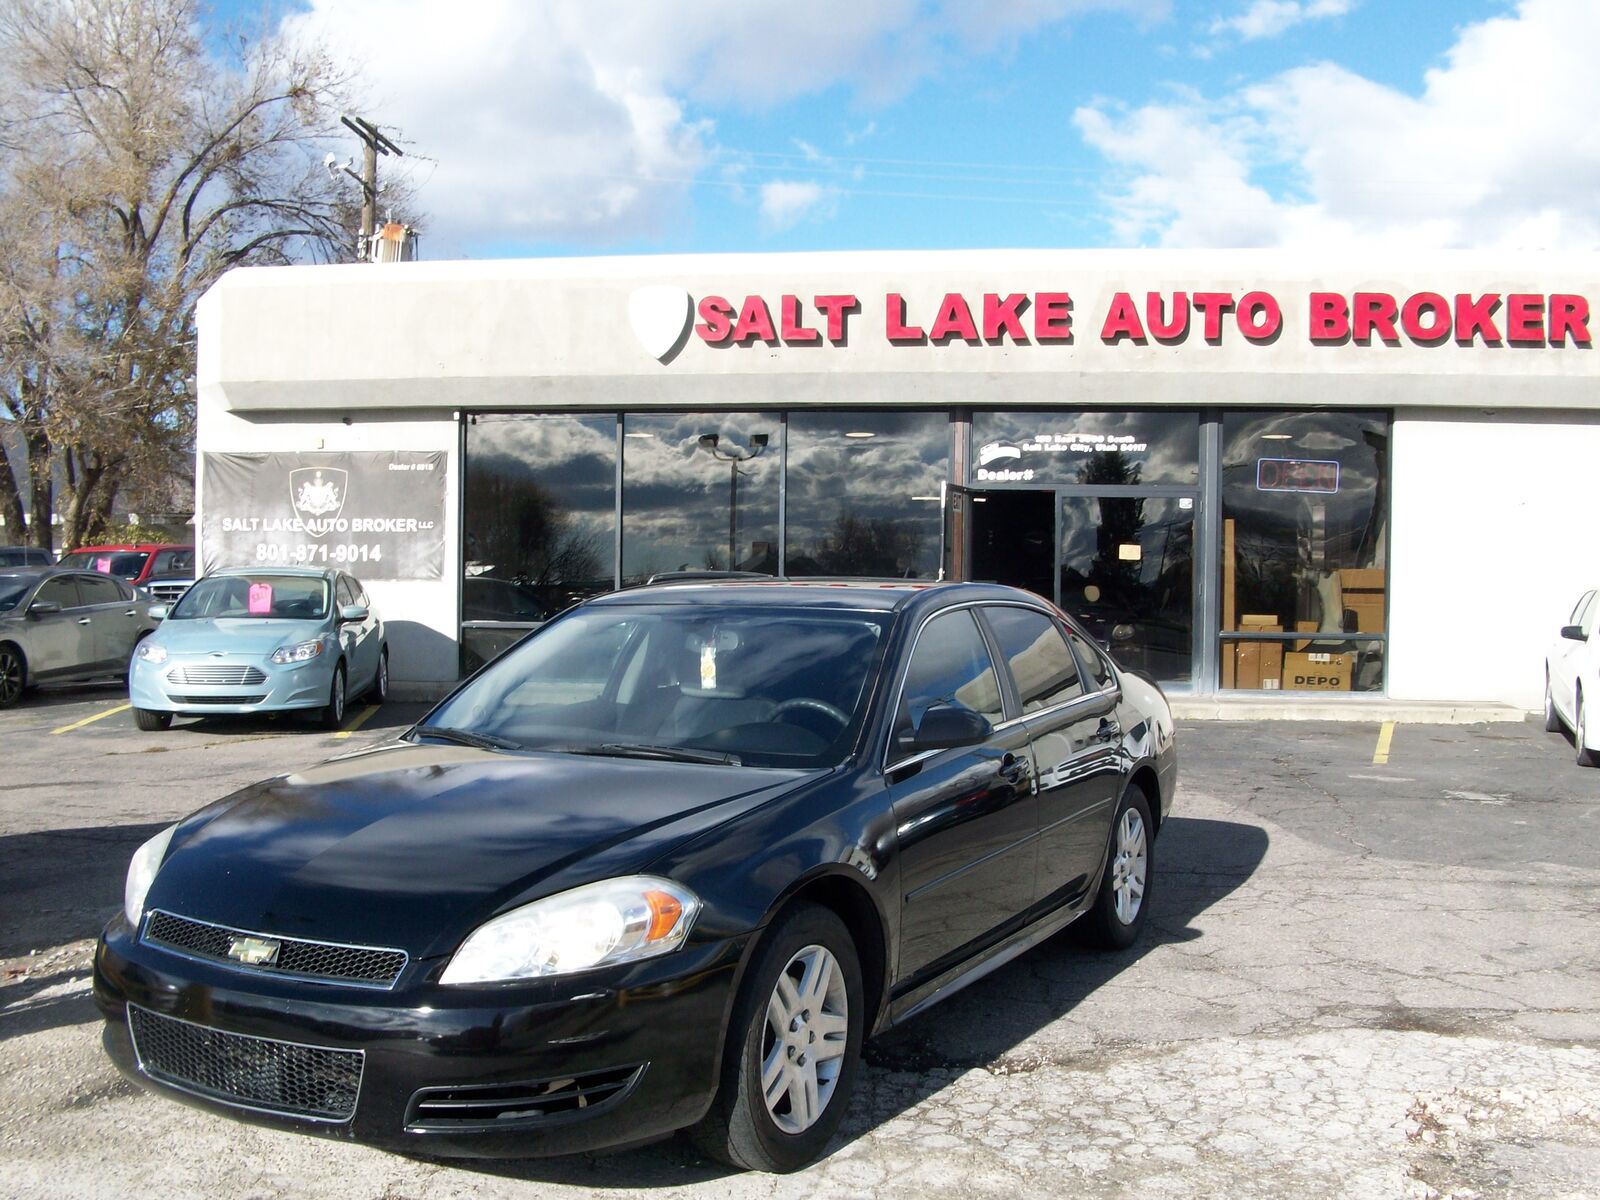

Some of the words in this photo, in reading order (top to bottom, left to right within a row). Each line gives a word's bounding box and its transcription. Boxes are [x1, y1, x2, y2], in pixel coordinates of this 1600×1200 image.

[695, 293, 861, 348] SALT
[886, 292, 1075, 347] LAKE
[1099, 291, 1284, 347] AUTO
[1309, 292, 1593, 349] BROKER
[1107, 435, 1135, 443] South
[1022, 443, 1042, 452] Salt
[1044, 443, 1068, 452] Lake
[1095, 443, 1118, 452] Utah
[222, 518, 259, 531] SALT
[263, 518, 301, 532] LAKE
[305, 518, 348, 532] AUTO
[352, 518, 418, 532] BROKER
[418, 520, 434, 529] LLC
[256, 544, 382, 562] 801-871-9014
[1294, 675, 1340, 686] DEPO
